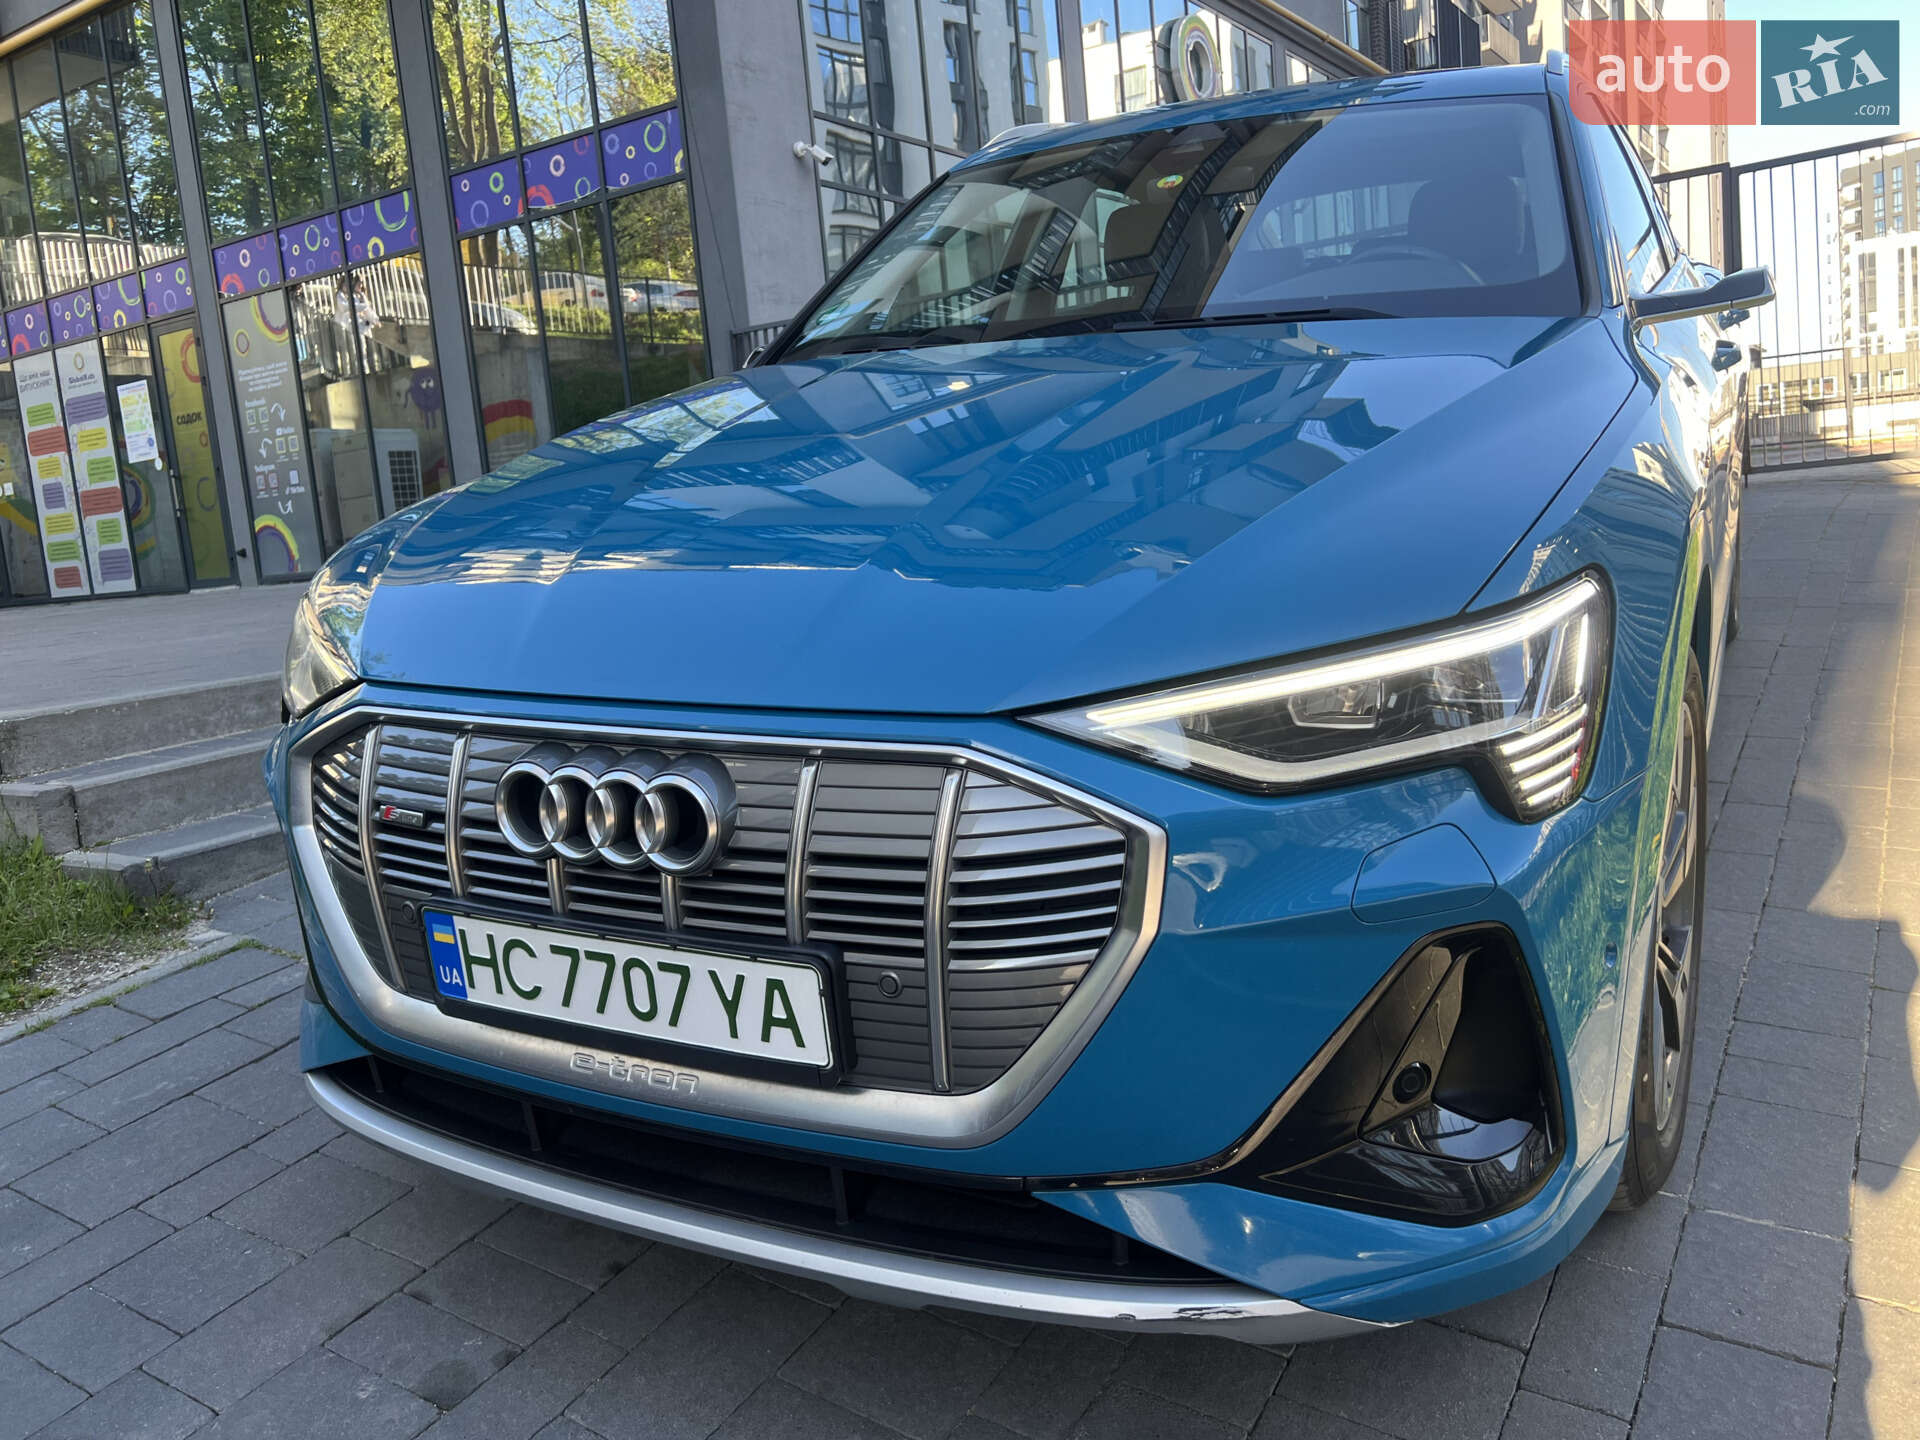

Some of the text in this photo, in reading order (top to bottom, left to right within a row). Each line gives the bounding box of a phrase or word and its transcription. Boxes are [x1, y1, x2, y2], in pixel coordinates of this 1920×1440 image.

[439, 965, 462, 987] UA
[458, 928, 806, 1049] HC 7707 YA
[570, 1052, 699, 1096] e-tron
